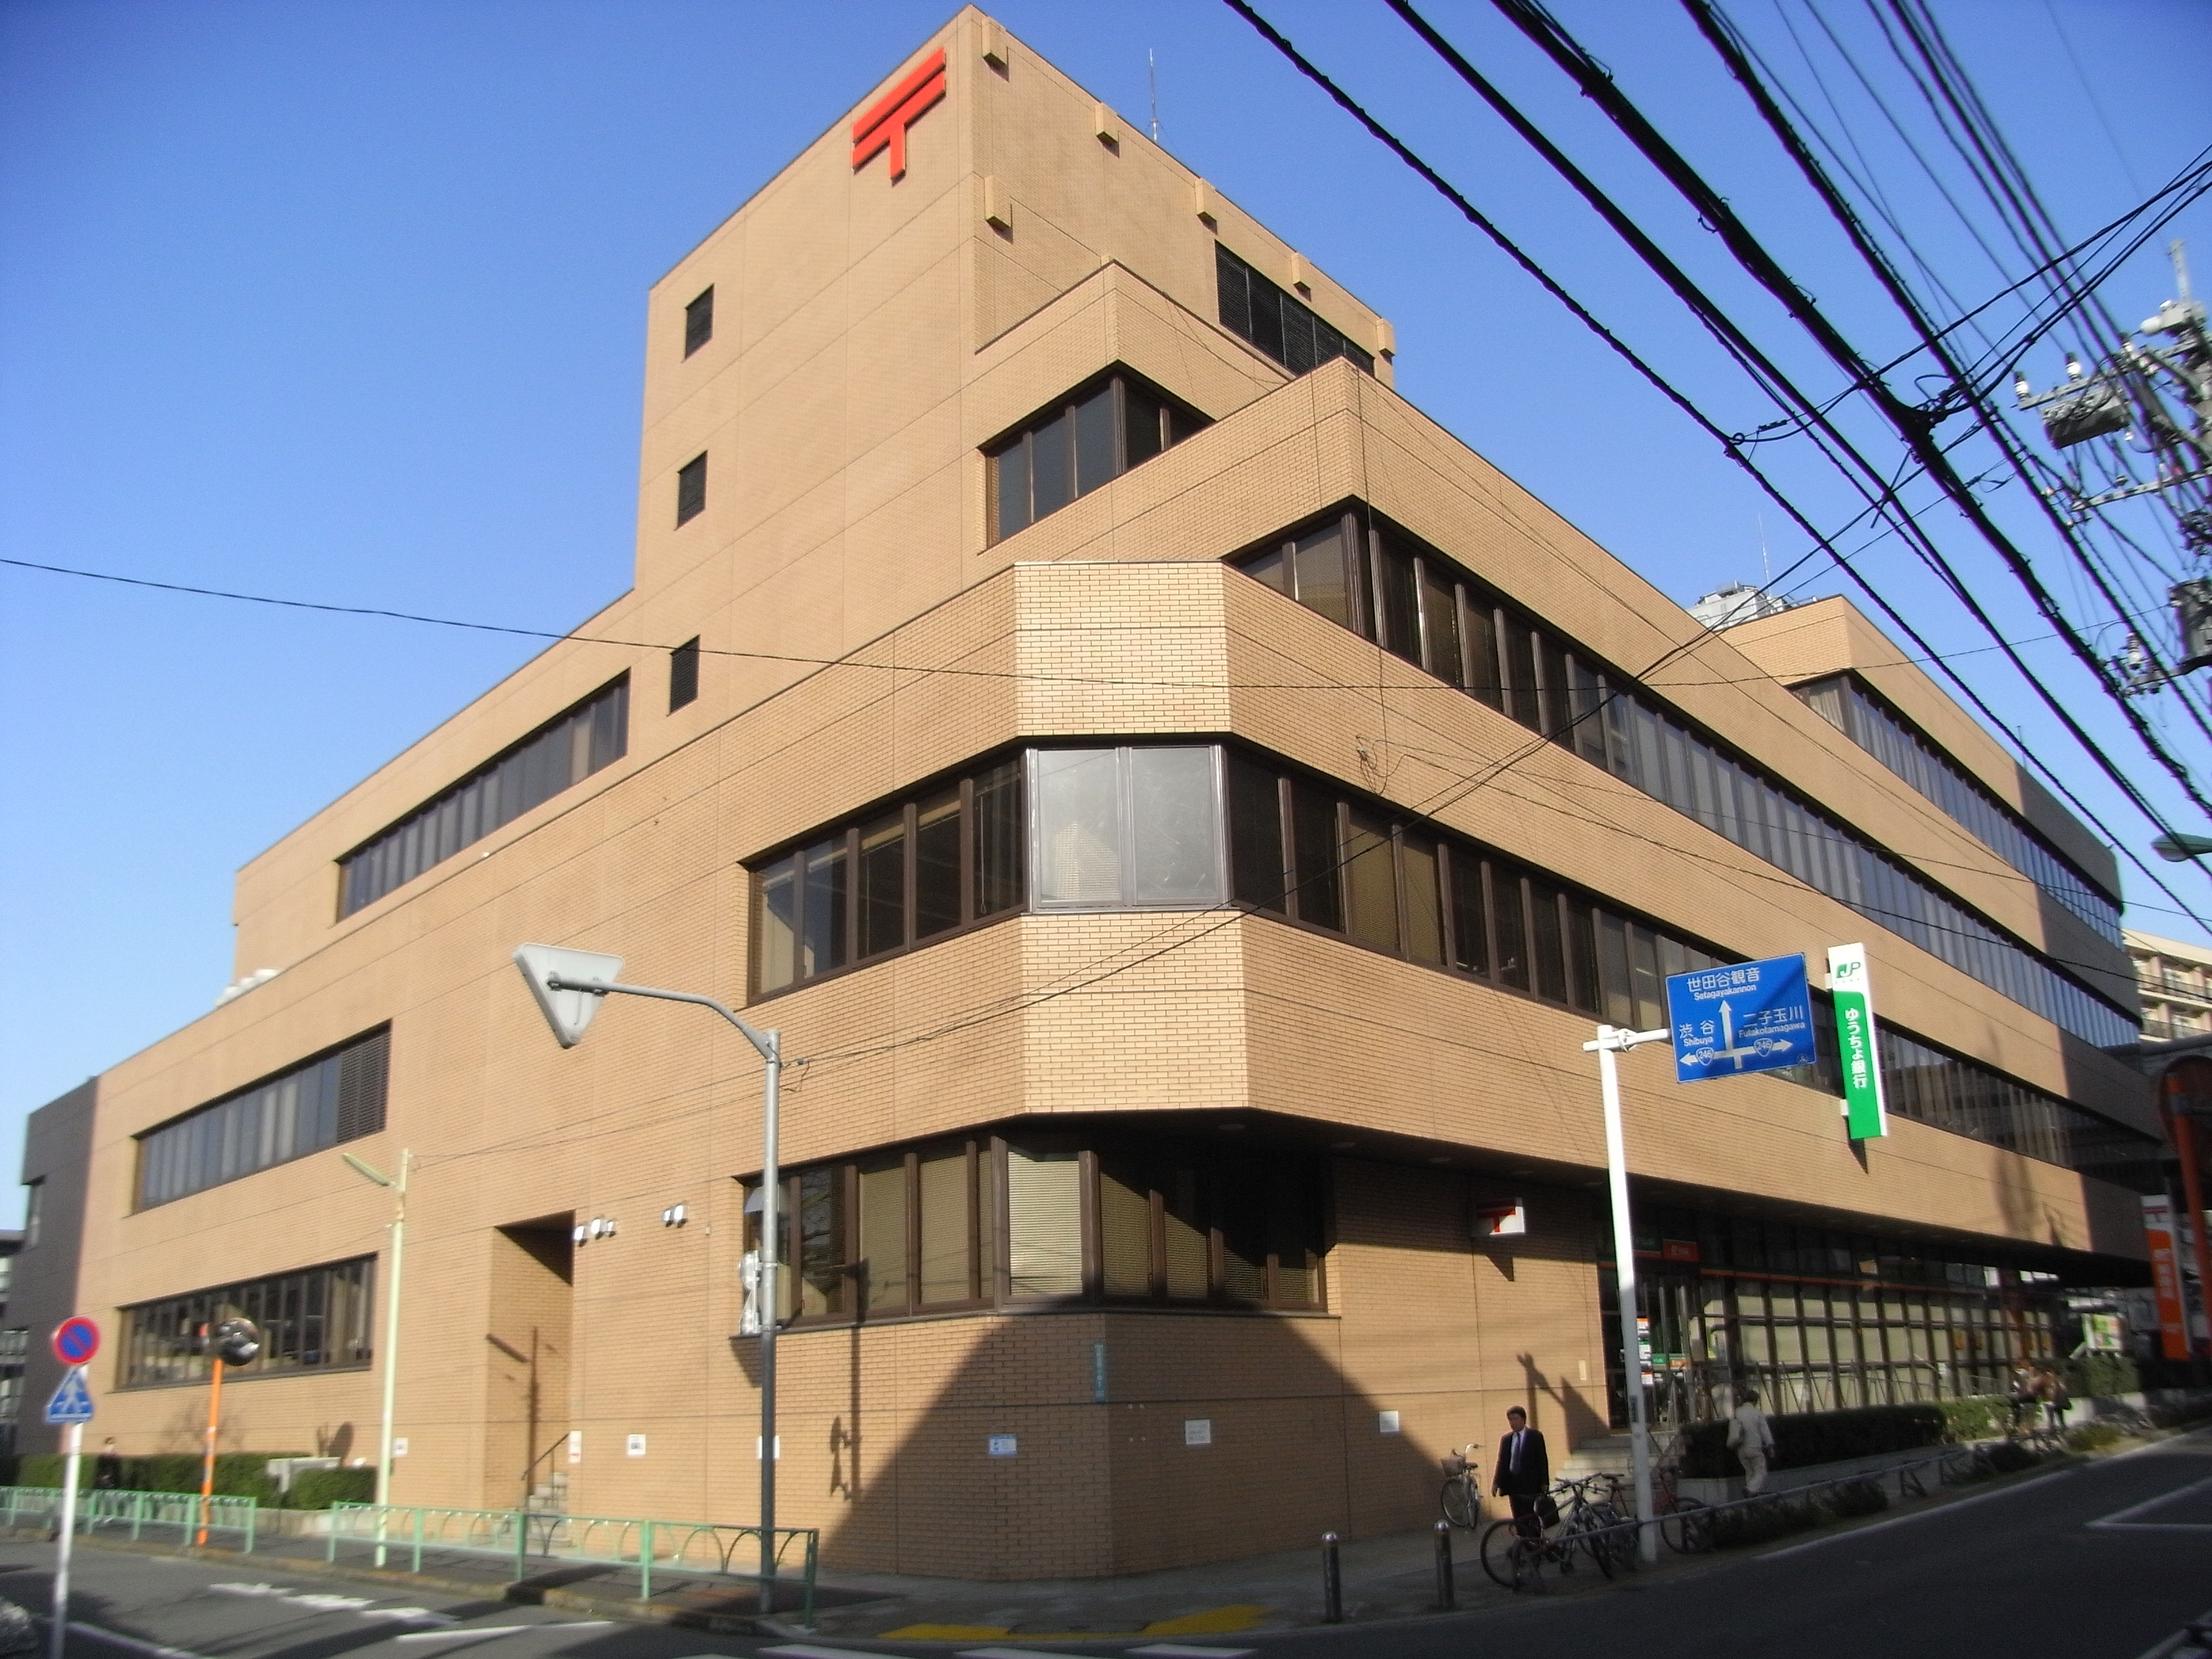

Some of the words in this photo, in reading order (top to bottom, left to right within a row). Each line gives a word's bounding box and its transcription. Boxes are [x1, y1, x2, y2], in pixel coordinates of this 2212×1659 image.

[1687, 967, 1760, 992] 世田谷観音
[1694, 984, 1757, 1000] Setagayakannon
[1743, 1005, 1803, 1027] 二子玉川
[1679, 1020, 1715, 1039] 渋谷
[1738, 1021, 1805, 1038] Futakotamagawa
[1683, 1036, 1713, 1047] Shibuya
[1756, 1040, 1771, 1050] 246
[1845, 1008, 1867, 1088] ゆうちょ銀行
